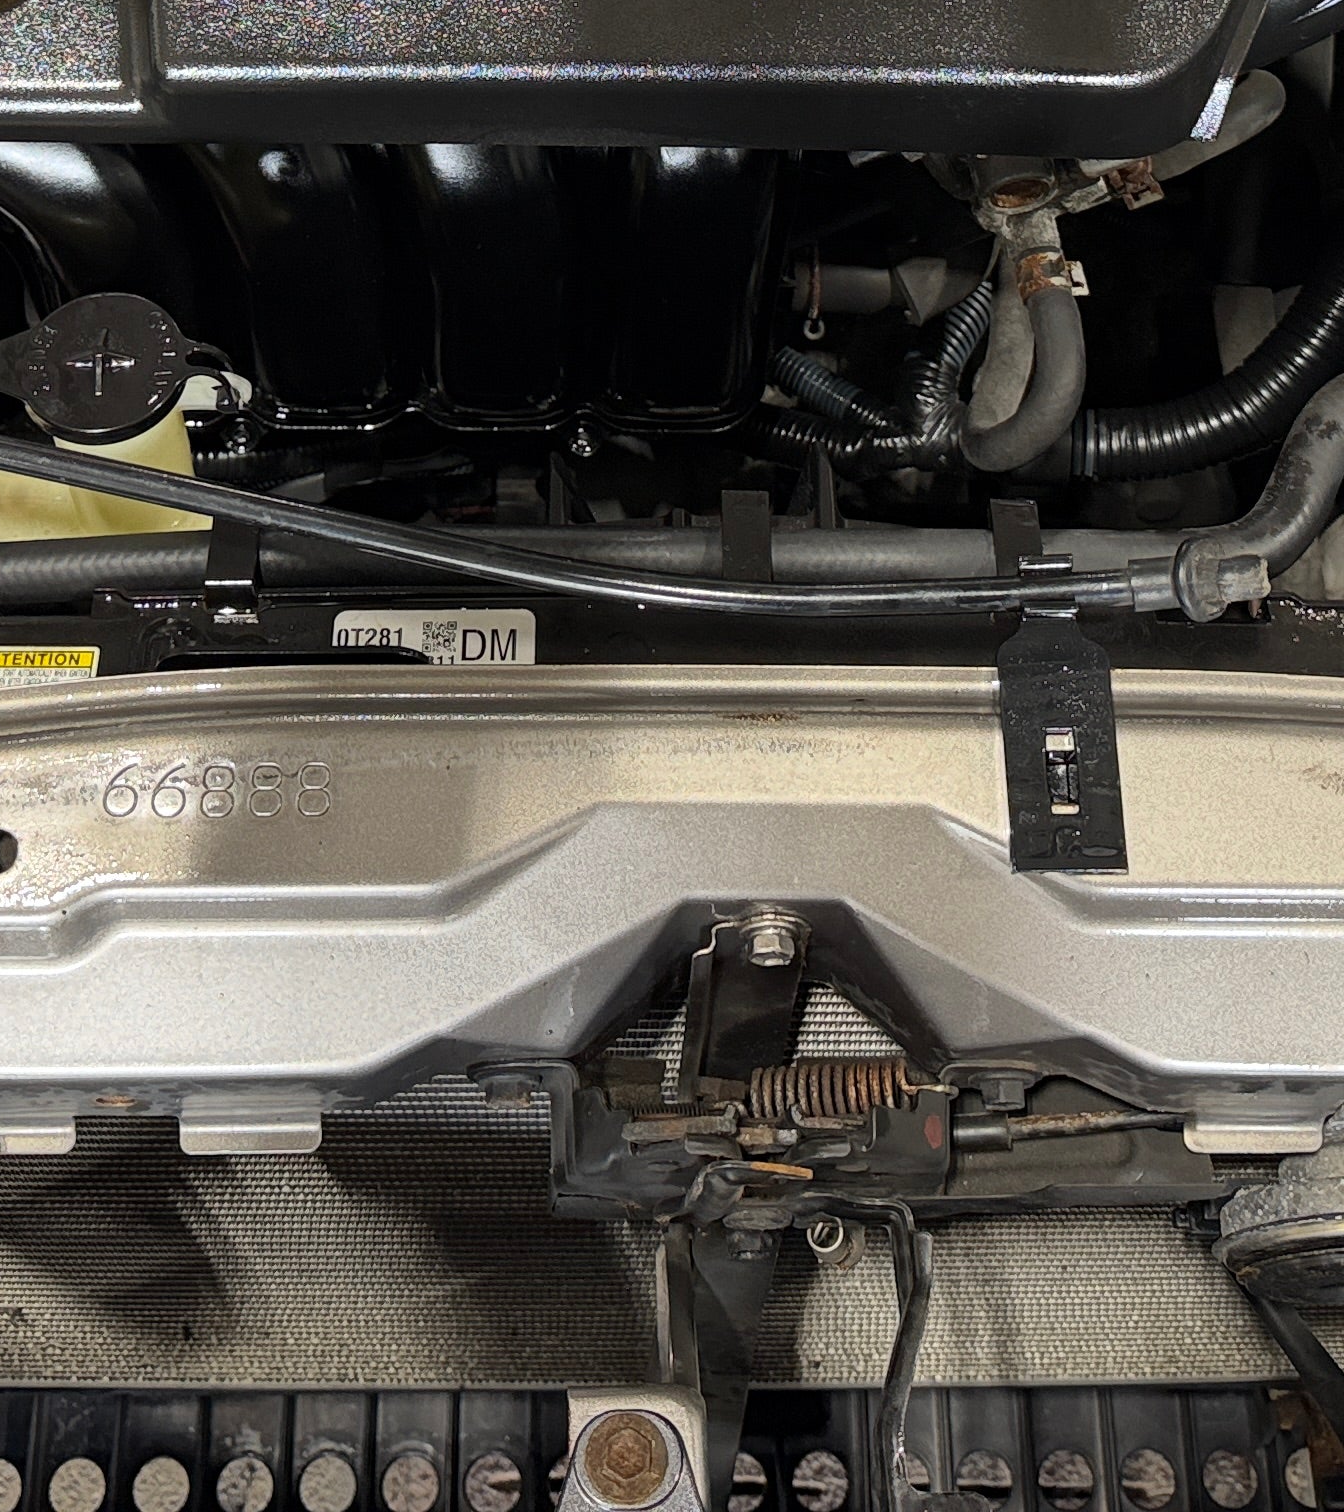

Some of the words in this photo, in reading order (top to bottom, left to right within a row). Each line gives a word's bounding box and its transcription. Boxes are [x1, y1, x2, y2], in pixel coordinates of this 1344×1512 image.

[337, 627, 403, 647] 0T281
[460, 628, 518, 662] DM
[102, 760, 331, 819] 66888
